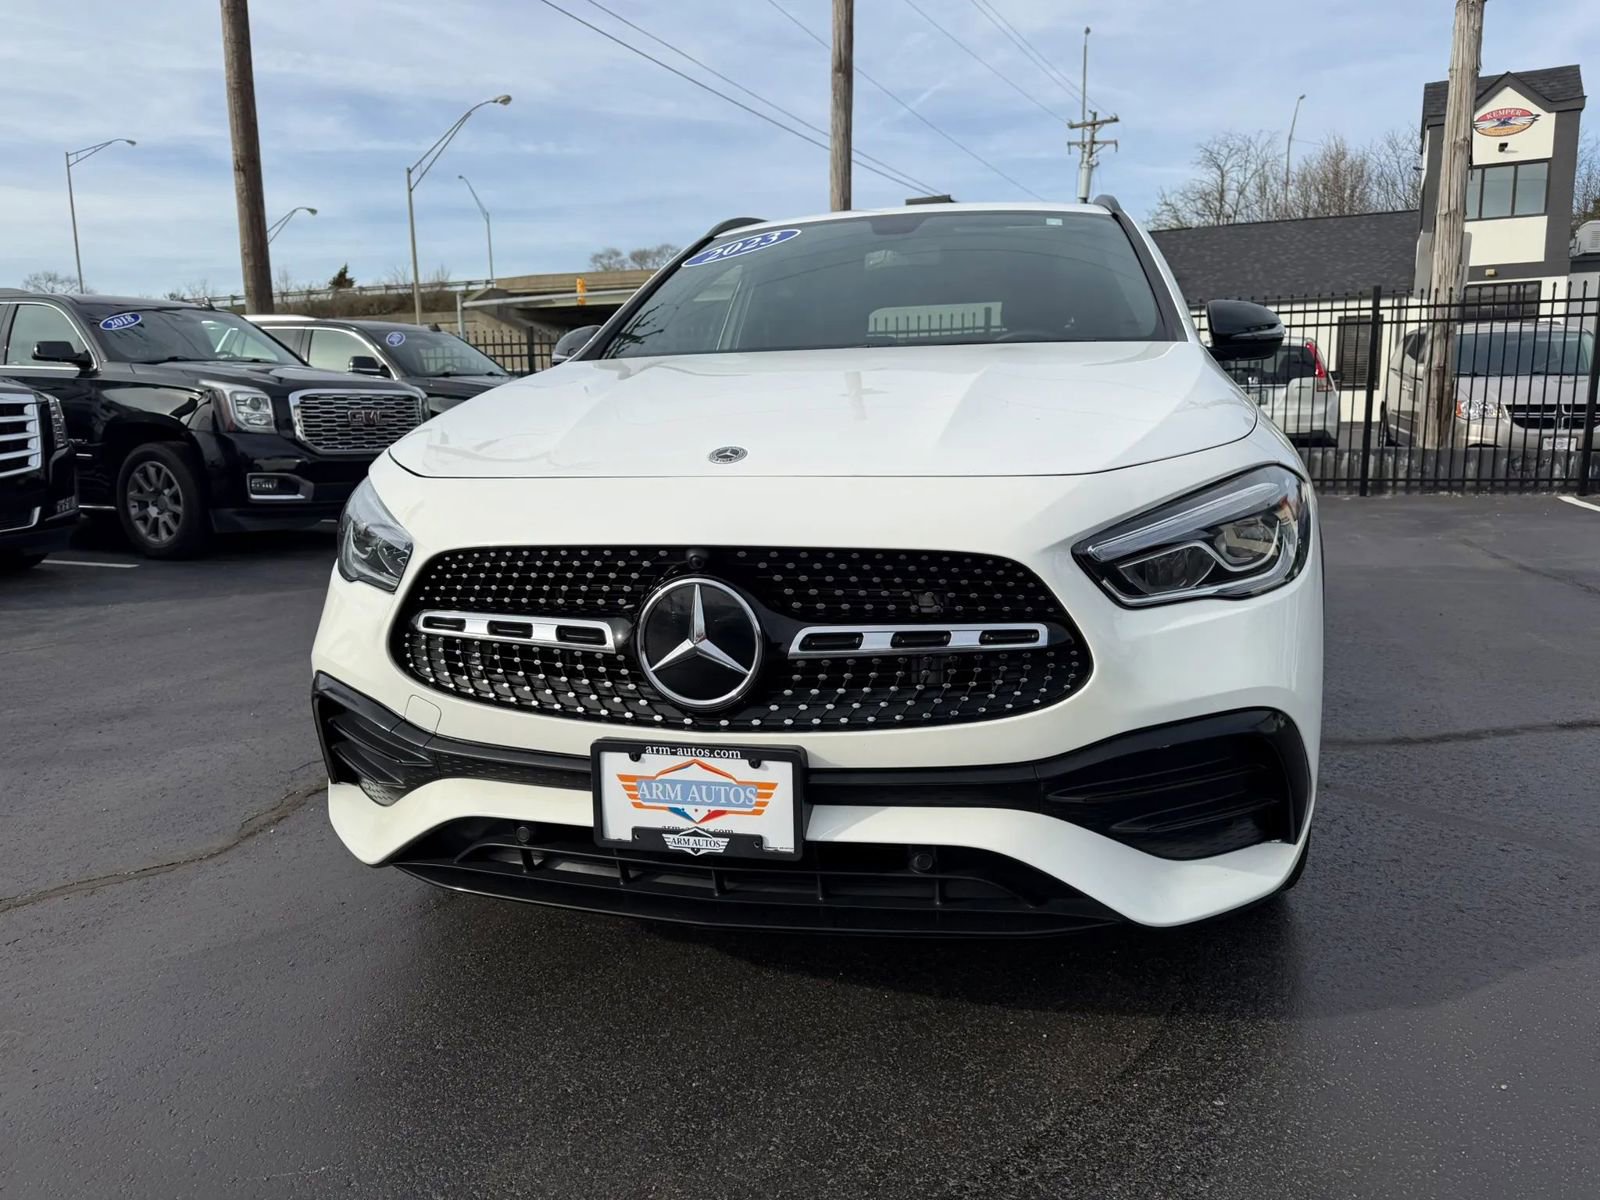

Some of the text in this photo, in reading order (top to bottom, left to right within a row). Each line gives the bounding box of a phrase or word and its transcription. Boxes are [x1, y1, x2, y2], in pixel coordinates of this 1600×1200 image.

[1486, 109, 1523, 120] KEMPER
[703, 232, 781, 263] 2023
[109, 314, 135, 328] 2018
[348, 410, 391, 425] GMC
[645, 745, 741, 759] arm-autos.com
[638, 780, 758, 805] ARM AUTOS
[671, 837, 721, 848] ARM AUTOS
